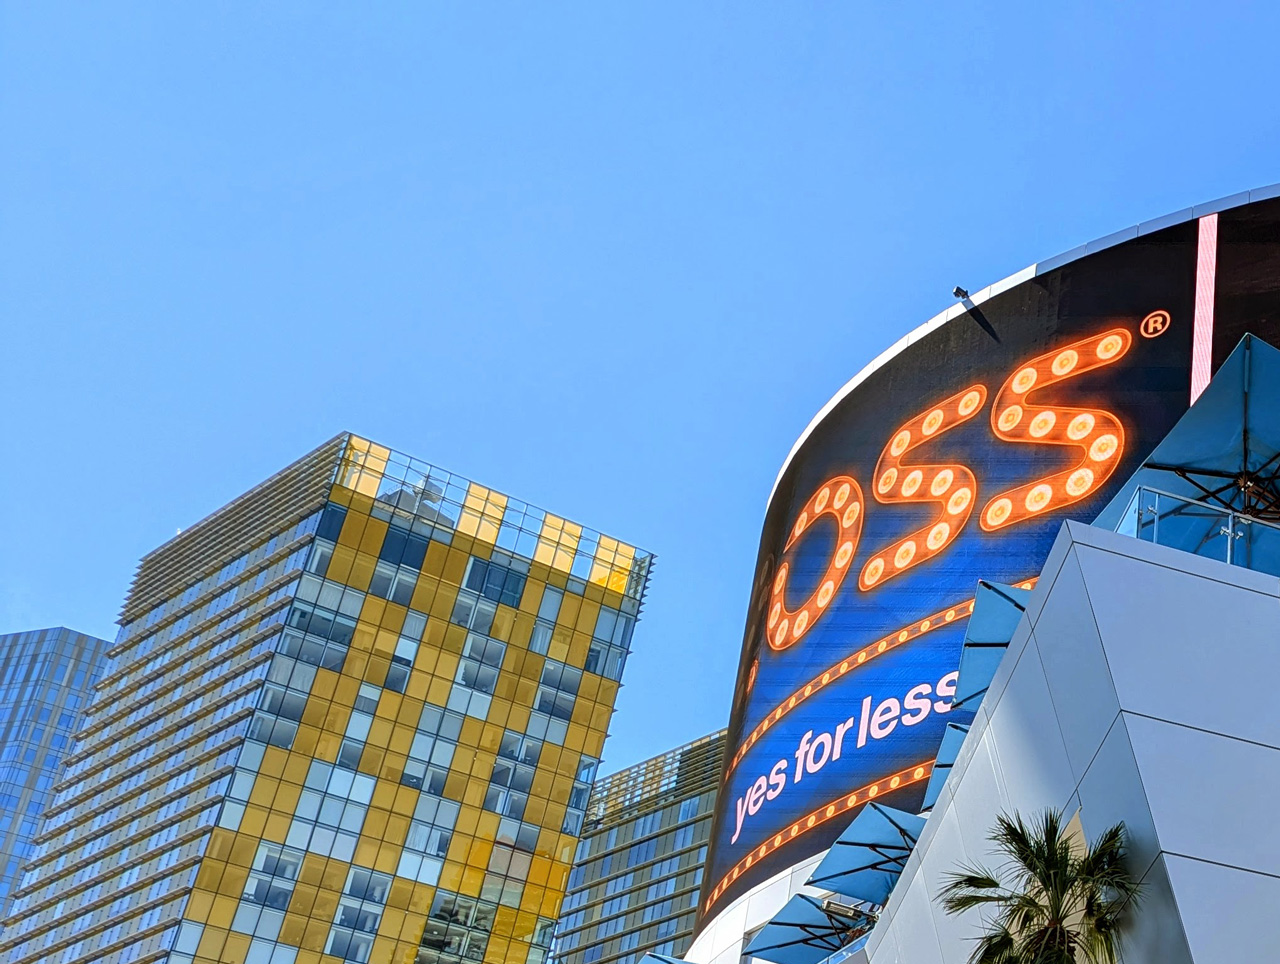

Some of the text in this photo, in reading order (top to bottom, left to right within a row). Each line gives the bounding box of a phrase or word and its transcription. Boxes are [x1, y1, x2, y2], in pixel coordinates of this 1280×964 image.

[731, 670, 959, 844] yes for less
